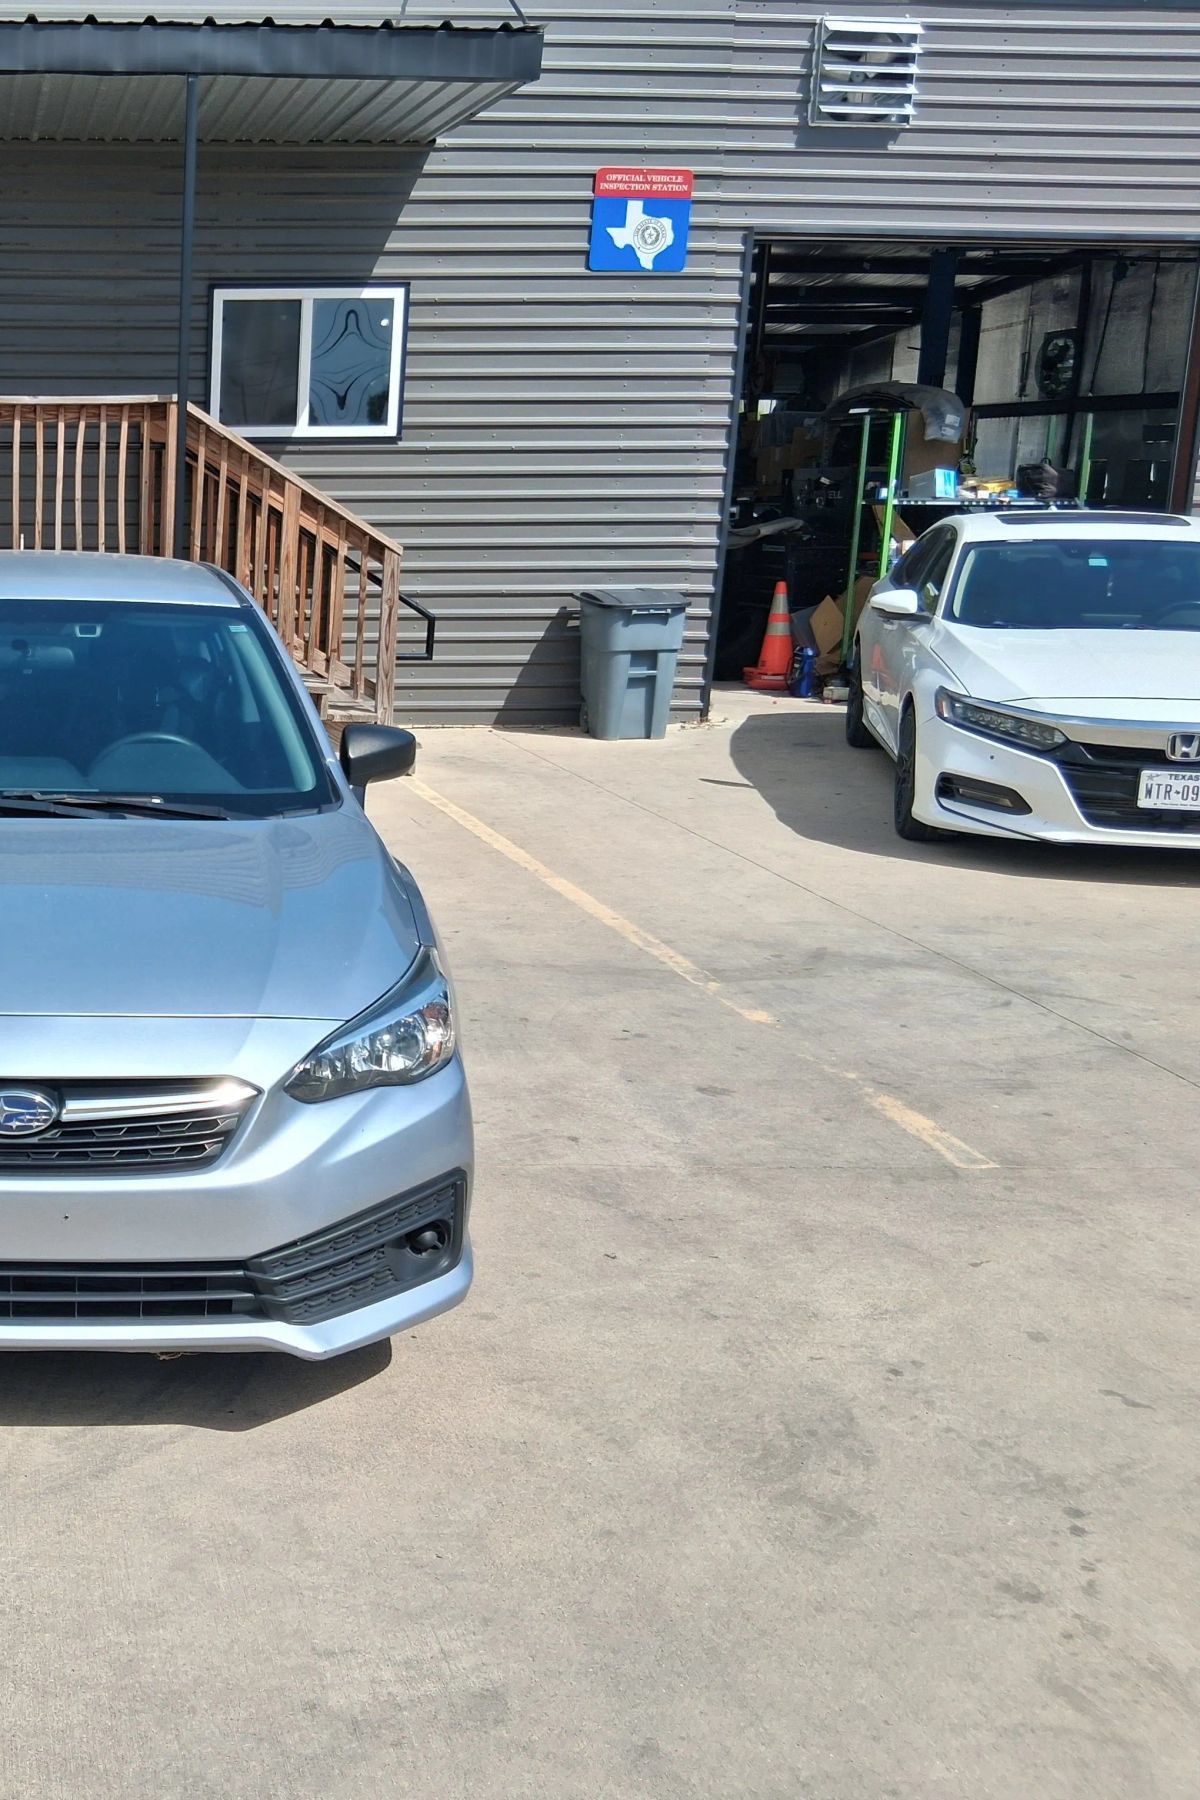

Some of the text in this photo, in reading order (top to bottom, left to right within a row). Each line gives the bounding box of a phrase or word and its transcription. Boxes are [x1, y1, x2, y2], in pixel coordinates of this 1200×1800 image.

[606, 174, 684, 183] OFFICIAL VEHICLE
[600, 182, 688, 192] INSPECTION STATION
[1168, 773, 1200, 781] TEXAS
